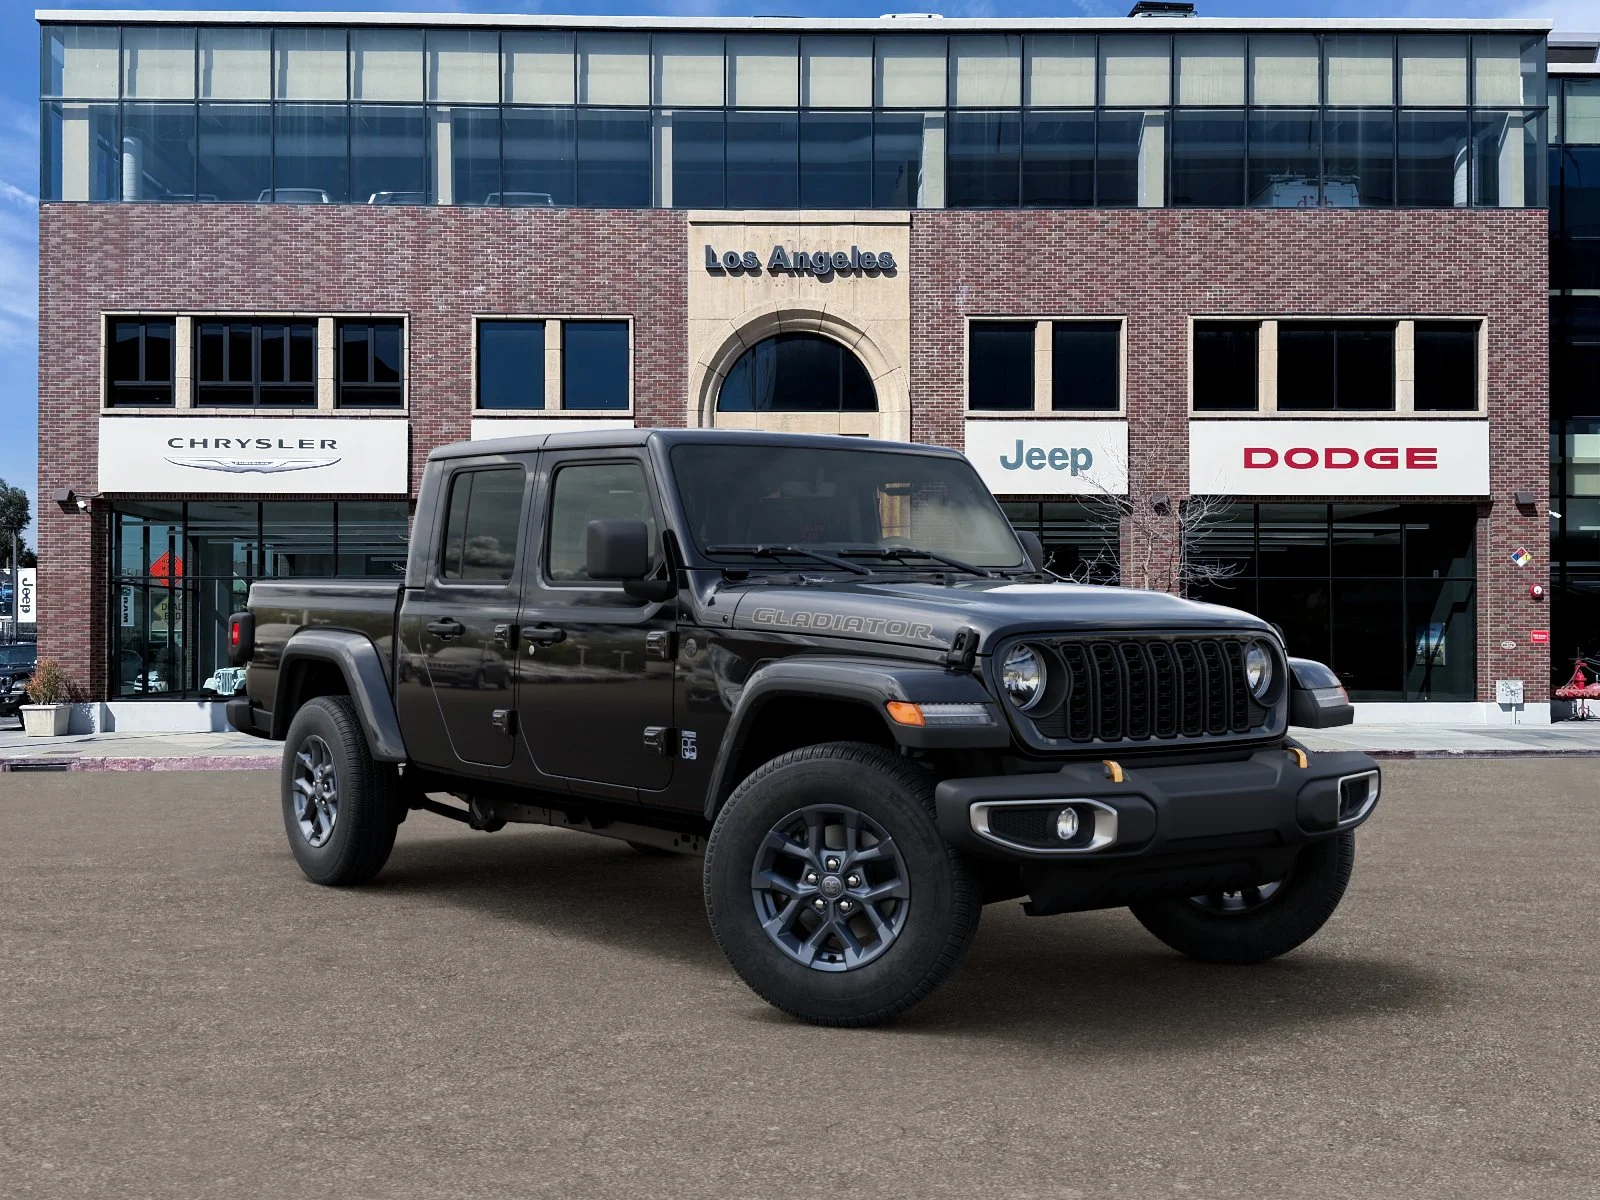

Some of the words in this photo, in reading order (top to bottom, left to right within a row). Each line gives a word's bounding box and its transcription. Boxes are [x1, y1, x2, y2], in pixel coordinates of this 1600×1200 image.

[705, 245, 758, 269] Los
[767, 245, 895, 275] Angeles
[167, 438, 338, 450] CHRYSLER
[1000, 439, 1093, 476] Jeep
[1244, 447, 1438, 469] DODGE
[20, 578, 33, 613] Jeep
[165, 612, 181, 620] ED
[752, 608, 933, 640] GLADIATOR
